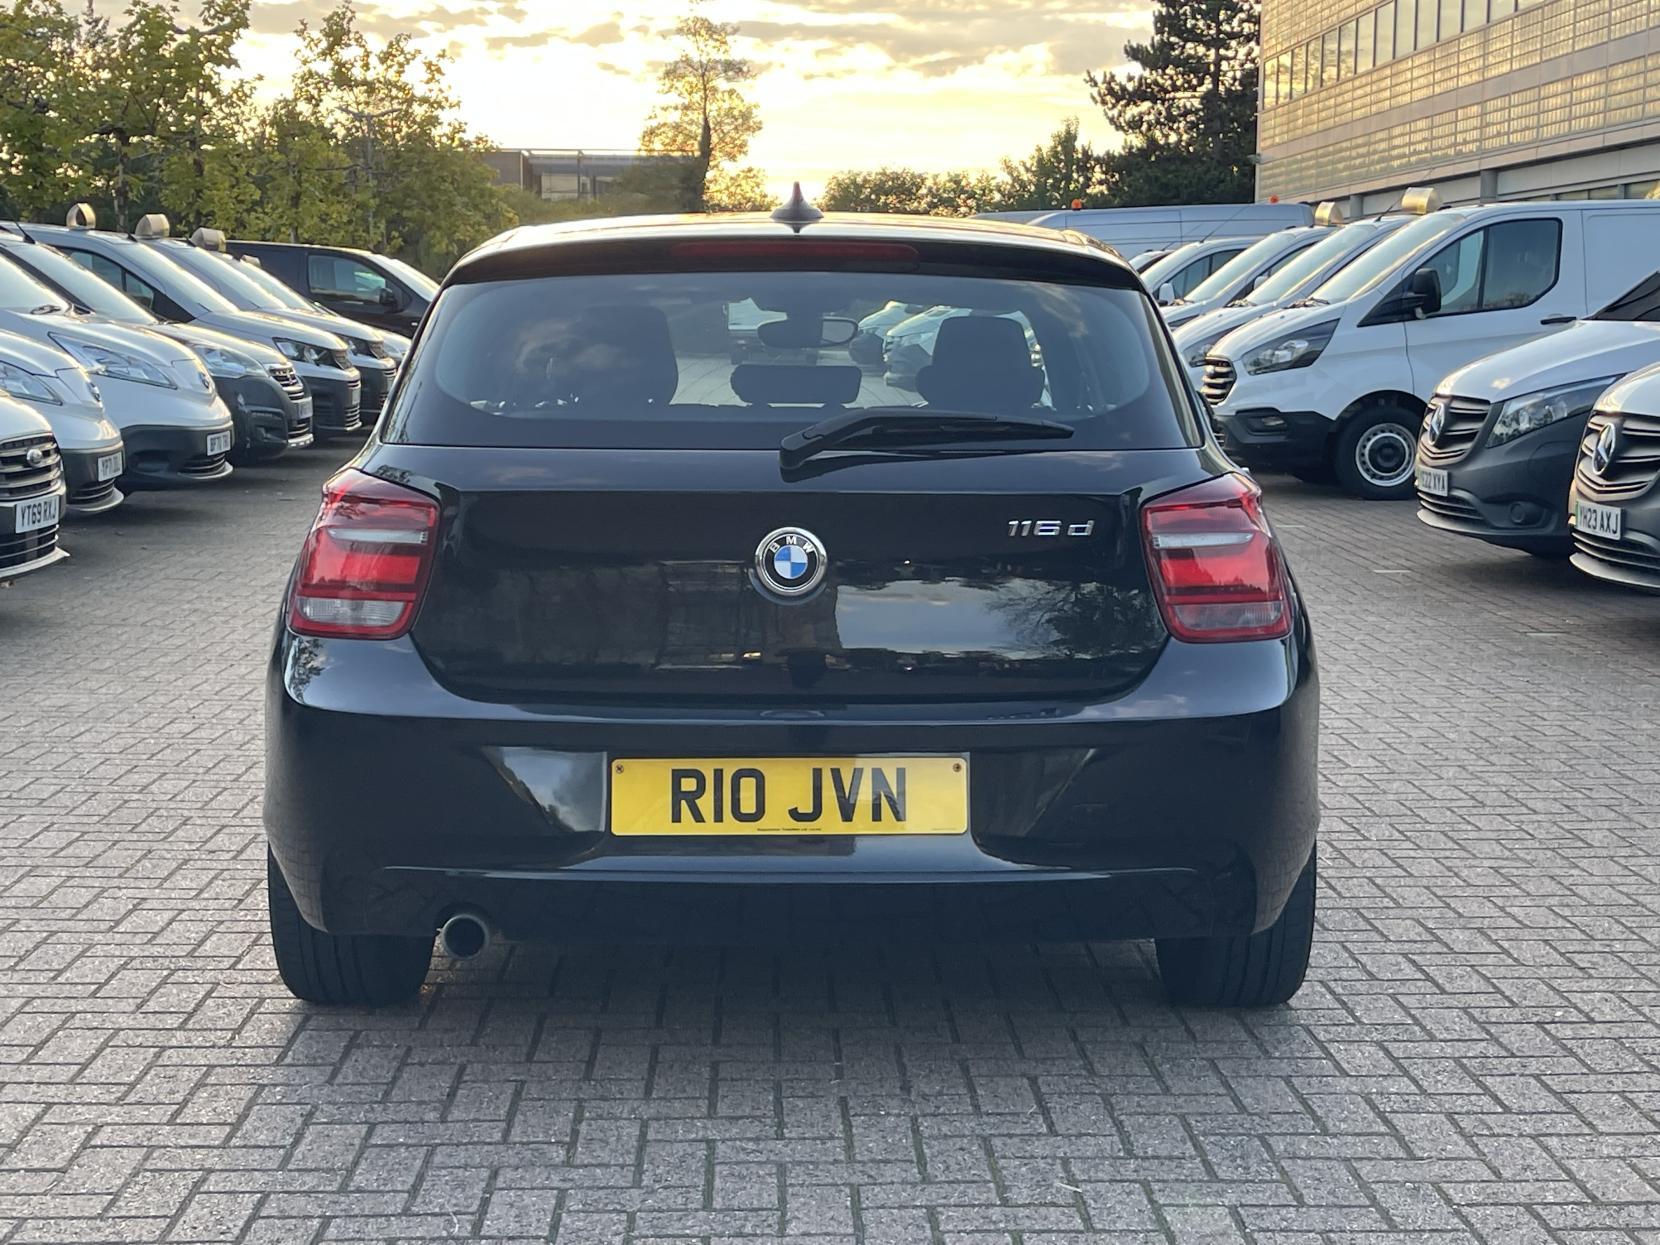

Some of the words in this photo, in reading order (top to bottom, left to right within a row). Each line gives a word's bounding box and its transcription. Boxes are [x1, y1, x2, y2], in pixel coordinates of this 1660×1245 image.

[20, 502, 42, 527] YT69
[43, 498, 57, 521] RXJ
[1600, 510, 1618, 534] AXJ
[769, 535, 815, 554] BMW
[788, 767, 907, 823] JVN
